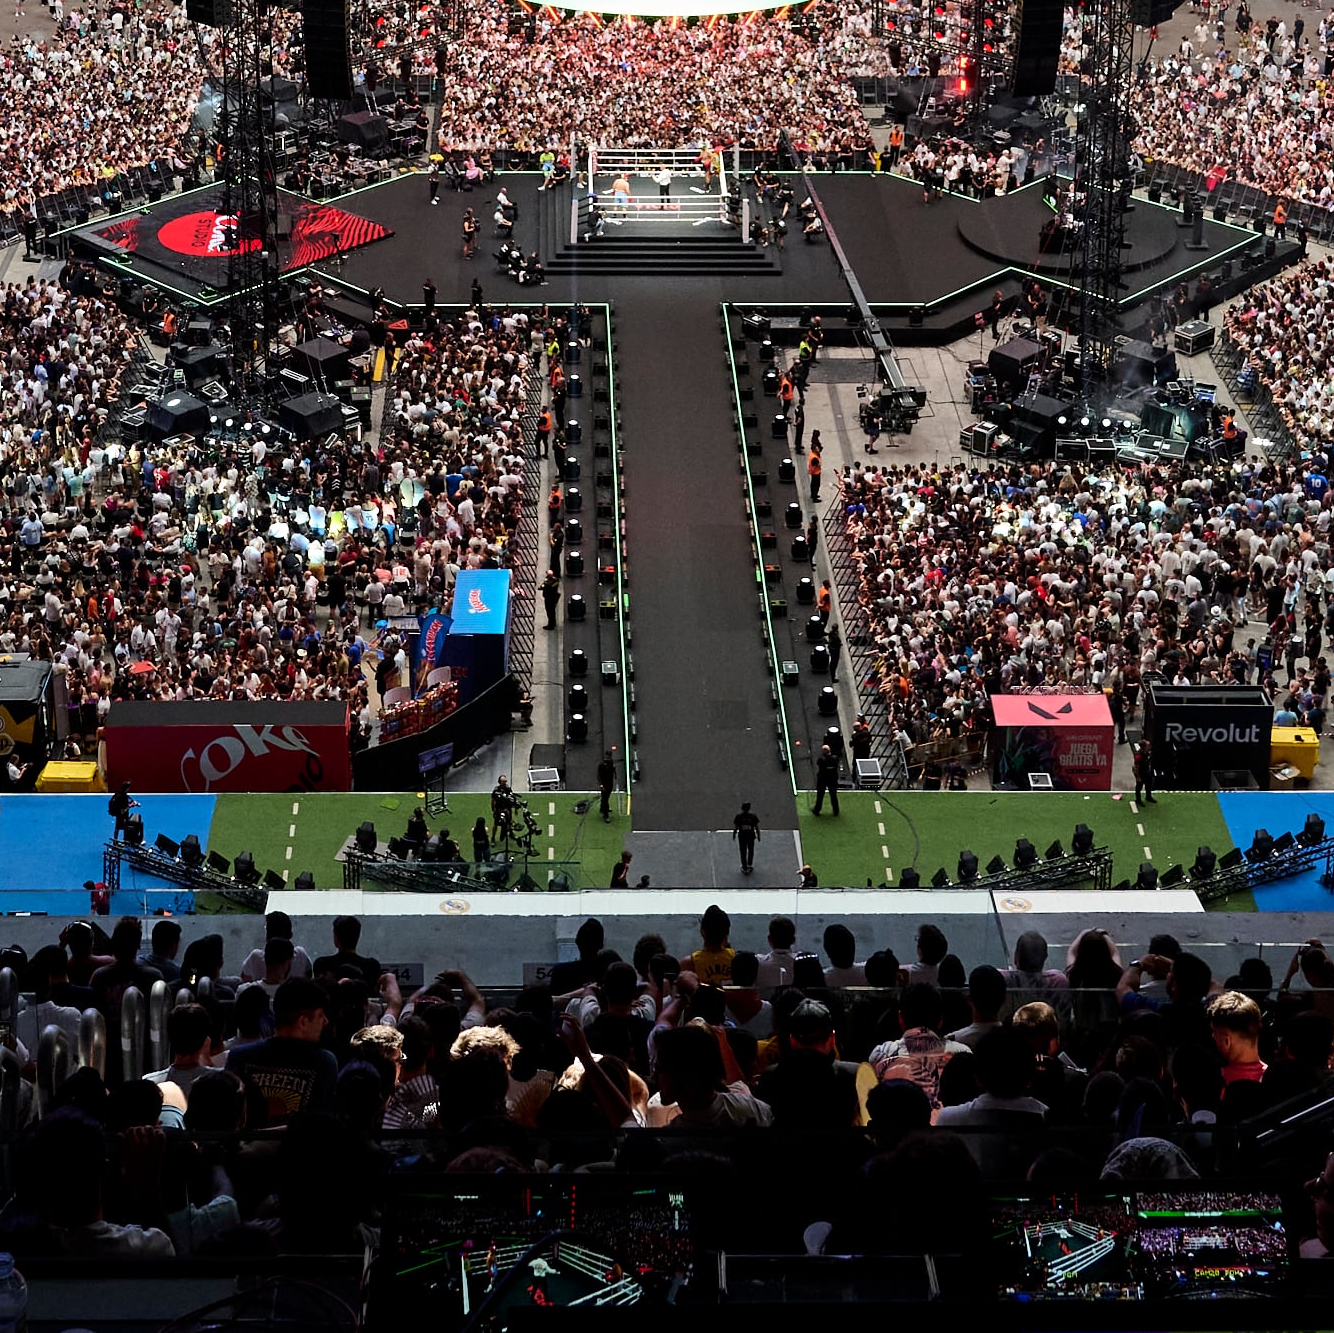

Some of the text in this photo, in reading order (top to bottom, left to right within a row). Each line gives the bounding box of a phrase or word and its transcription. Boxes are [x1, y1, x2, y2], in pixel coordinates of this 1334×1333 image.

[1165, 723, 1260, 743] Revolut
[1070, 743, 1099, 755] JUEGA
[1058, 754, 1107, 766] GRATIS YA
